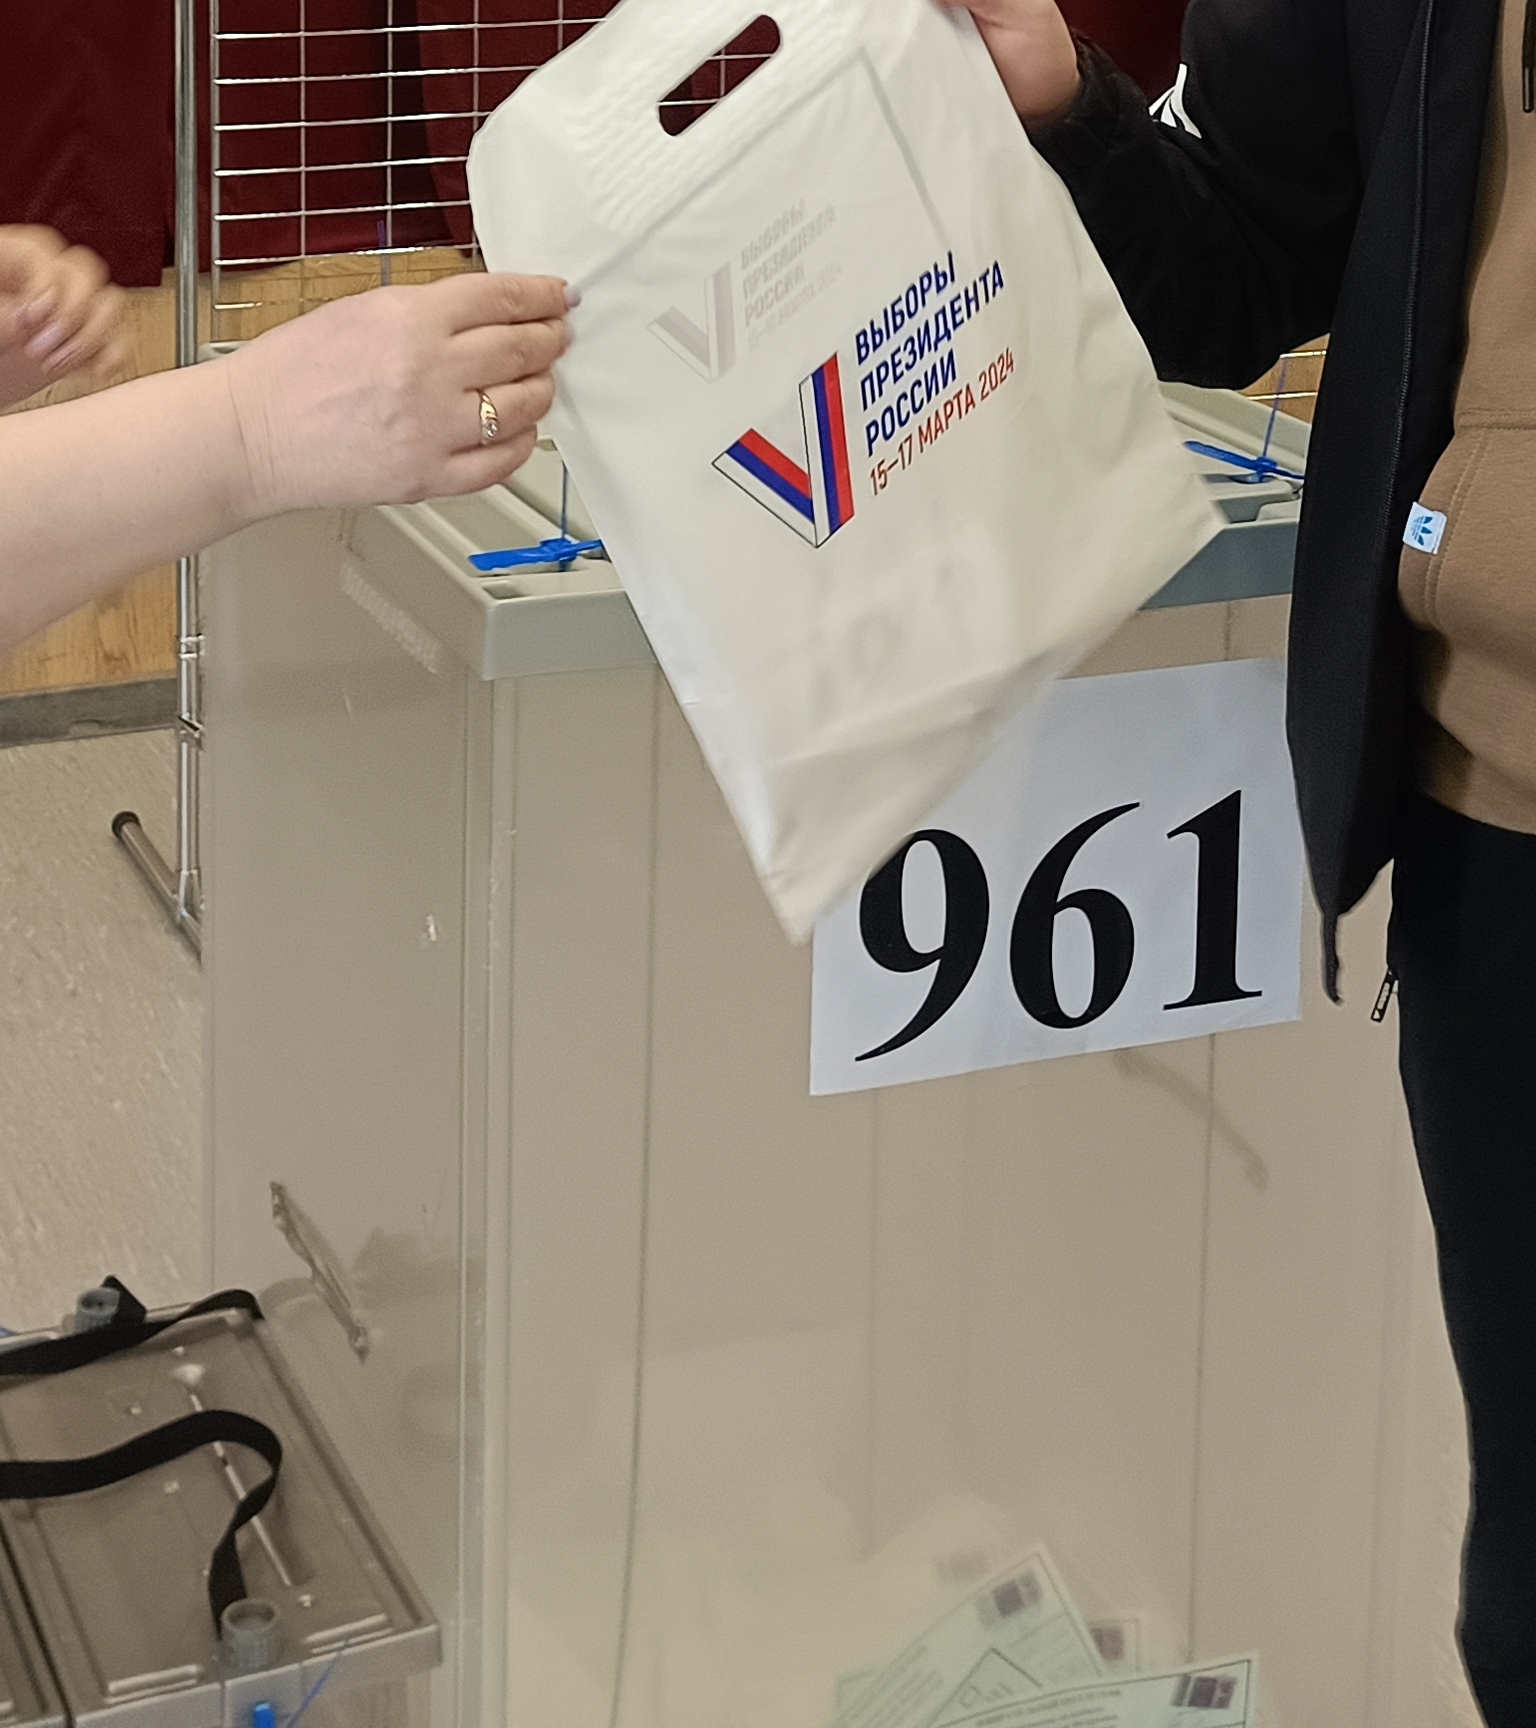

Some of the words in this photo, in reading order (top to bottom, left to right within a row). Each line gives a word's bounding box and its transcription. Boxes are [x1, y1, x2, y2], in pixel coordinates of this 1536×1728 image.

[855, 250, 955, 366] ВЫБОРЫ
[860, 260, 1004, 412] ПРЕЗИДЕНТА
[865, 348, 957, 458] РОССИИ
[918, 382, 976, 454] МАРТА
[978, 346, 1014, 403] 2024
[855, 789, 1262, 1062] 961
